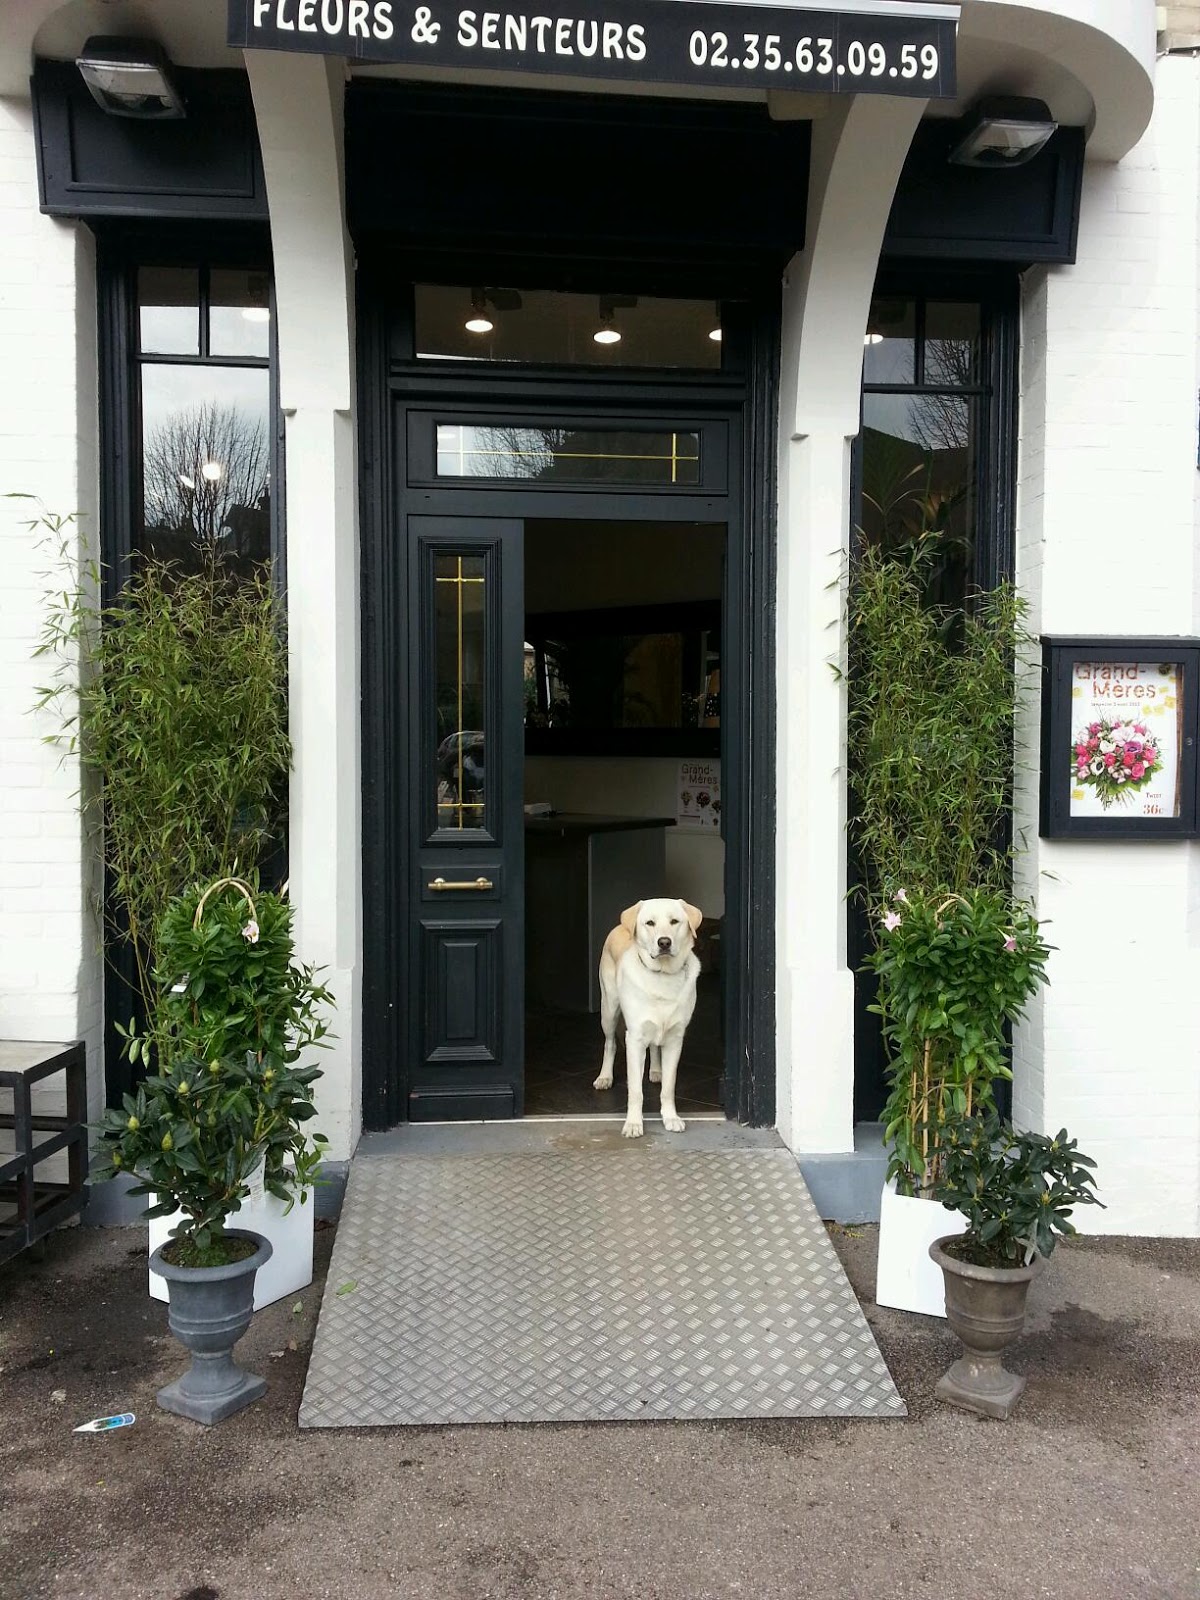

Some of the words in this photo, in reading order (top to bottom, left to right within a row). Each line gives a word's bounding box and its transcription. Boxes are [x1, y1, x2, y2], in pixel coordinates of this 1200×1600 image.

[253, 0, 394, 40] FLEURS
[411, 6, 441, 44] &
[457, 8, 648, 62] SENTEURS
[689, 29, 939, 81] 02.35.63.09.59
[1076, 662, 1147, 680] Grand-
[1093, 680, 1157, 699] Mères
